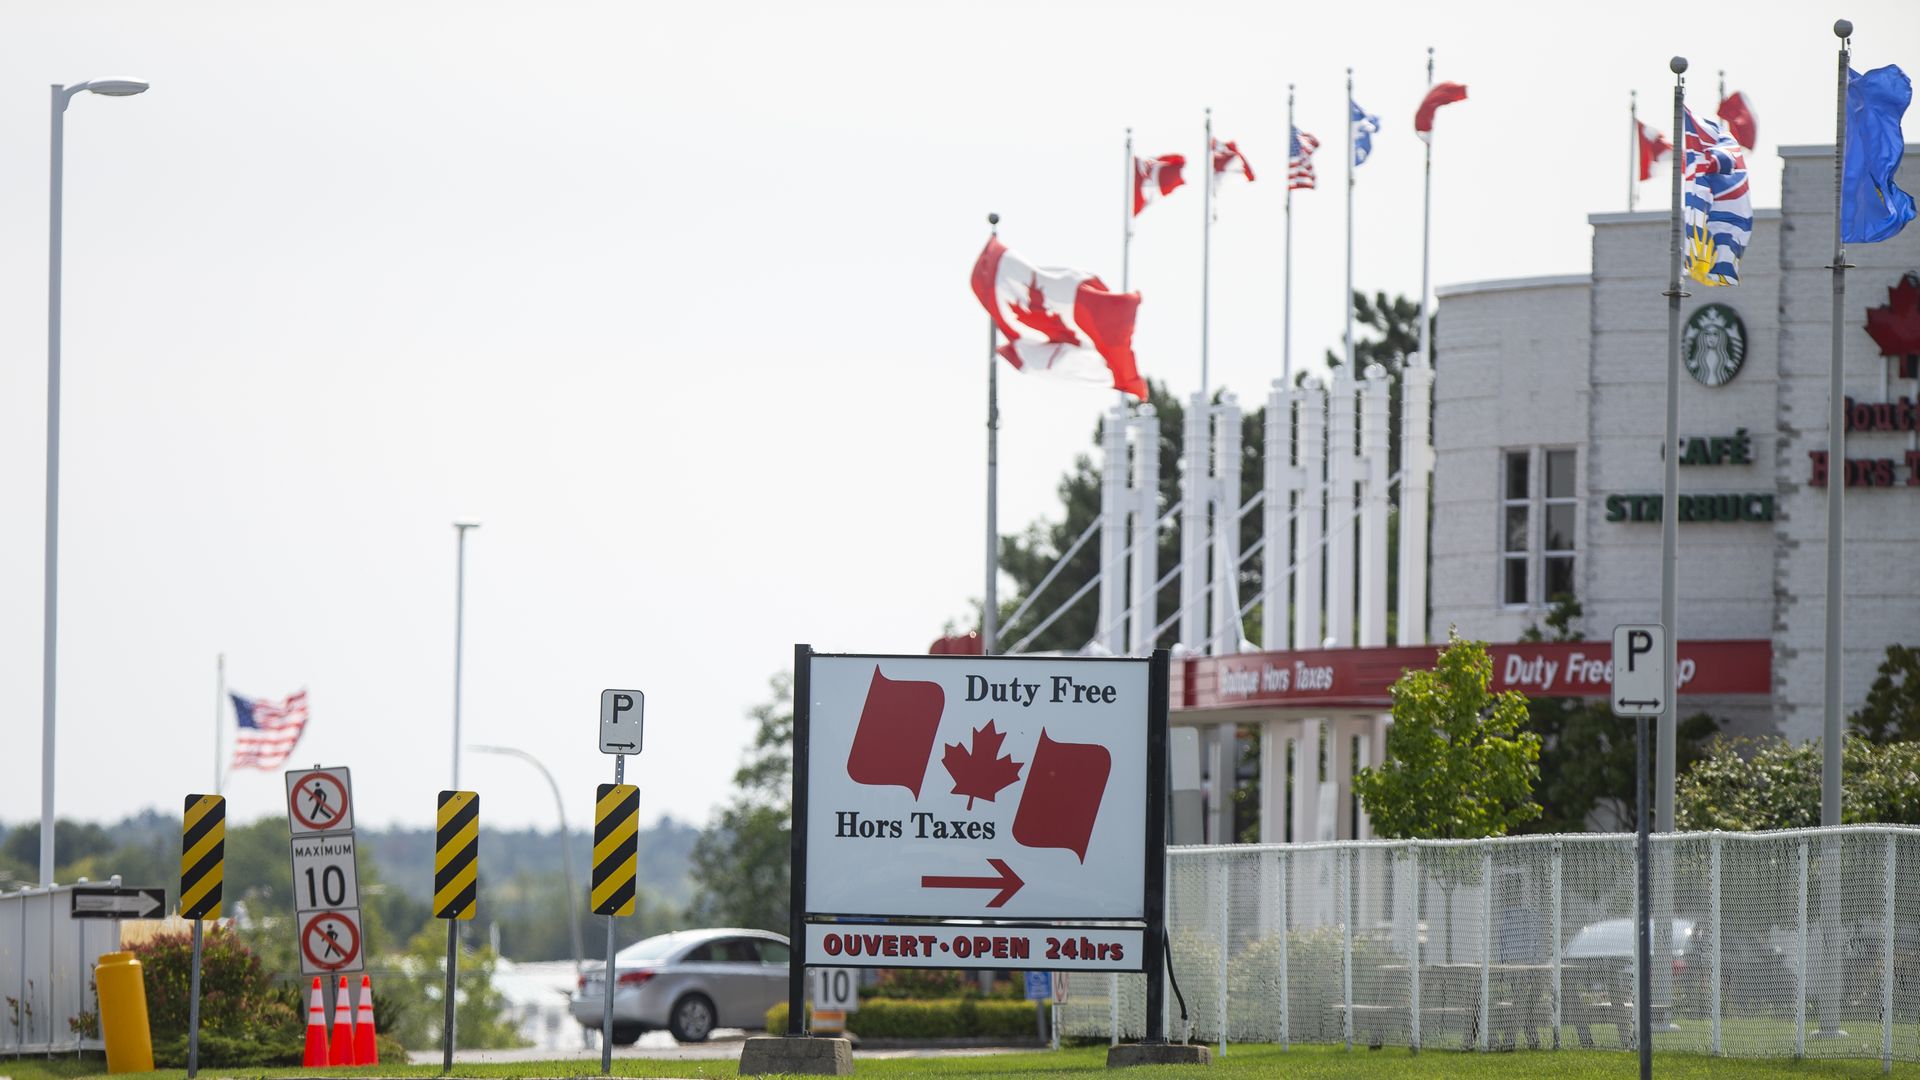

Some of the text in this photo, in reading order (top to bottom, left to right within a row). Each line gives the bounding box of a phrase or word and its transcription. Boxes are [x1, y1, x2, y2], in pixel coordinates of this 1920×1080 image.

[1628, 629, 1653, 672] P
[1263, 663, 1290, 693] Hors
[1295, 660, 1334, 691] Taxes
[1504, 653, 1613, 690] Duty Free
[965, 674, 1117, 708] Duty Free
[613, 694, 634, 724] P
[835, 811, 996, 840] Hors Taxes
[295, 844, 352, 858] MAXIMUM
[305, 864, 346, 908] 10
[1045, 936, 1124, 961] 24hrs
[822, 969, 849, 1004] 10
